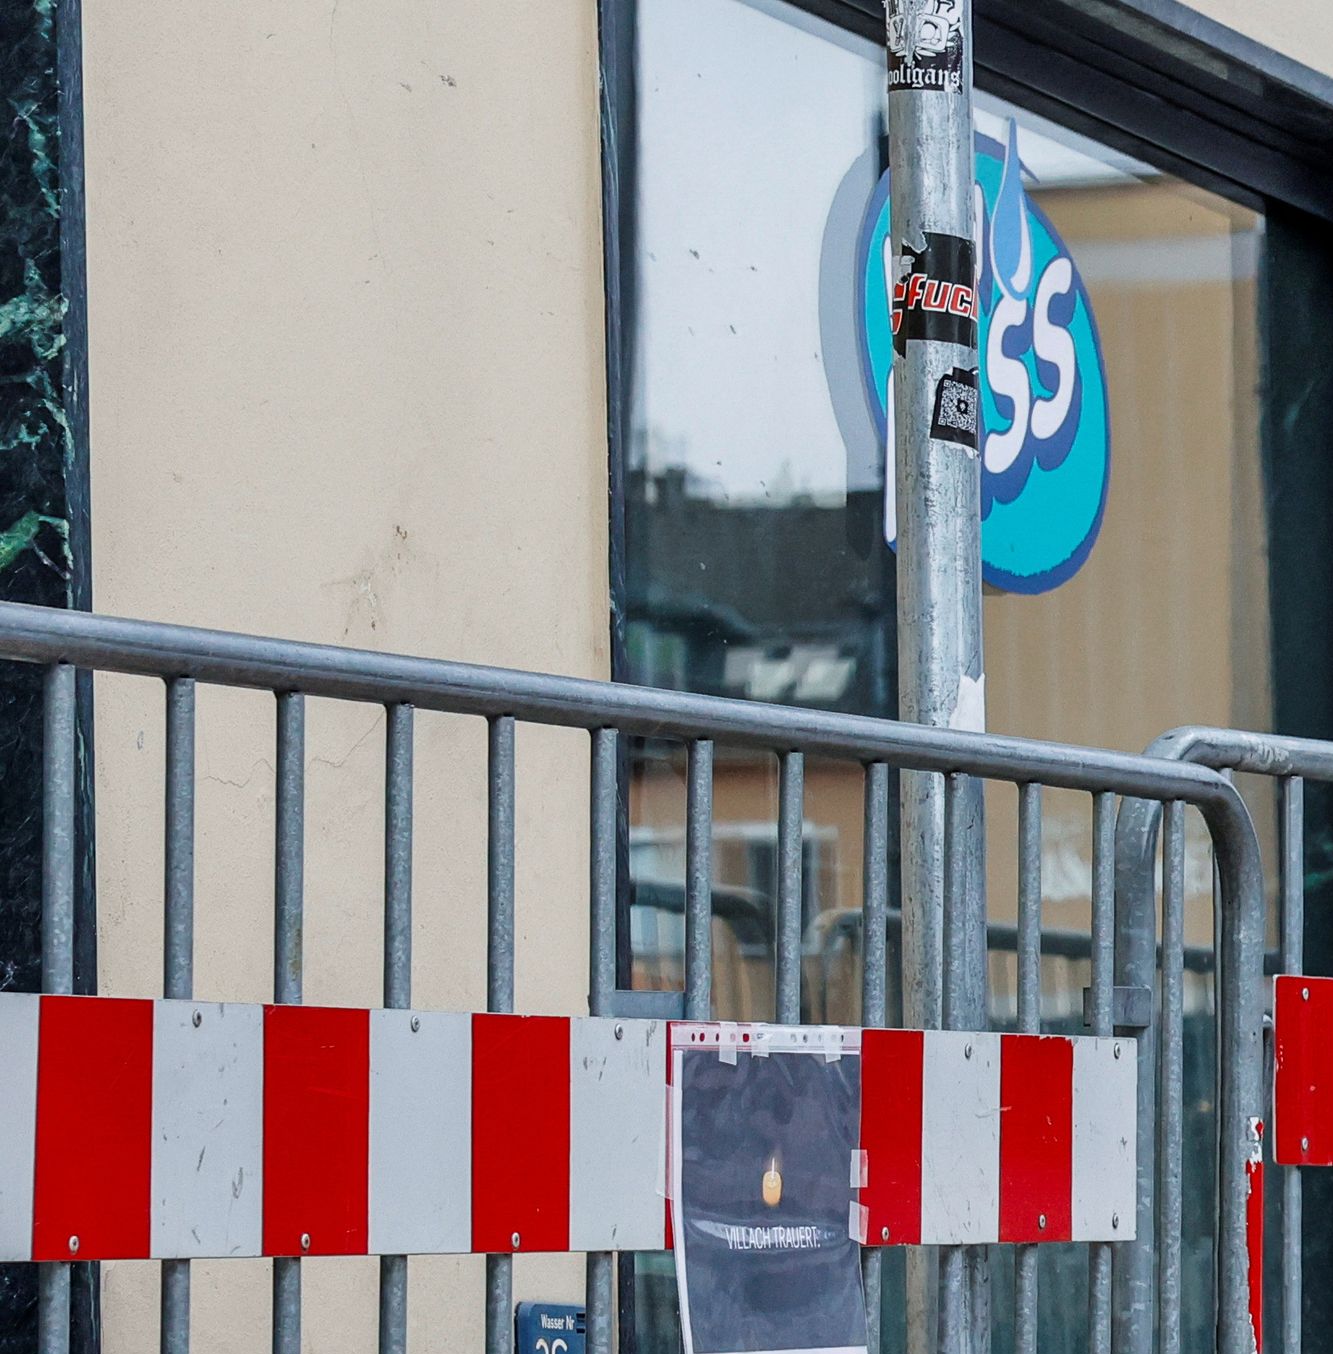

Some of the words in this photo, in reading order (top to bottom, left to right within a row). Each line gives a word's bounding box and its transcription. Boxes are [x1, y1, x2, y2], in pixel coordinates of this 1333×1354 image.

[725, 1226, 770, 1250] VILLACH
[772, 1225, 821, 1249] TRAUERT.
[540, 1313, 565, 1329] Wasser
[566, 1315, 575, 1331] Nr
